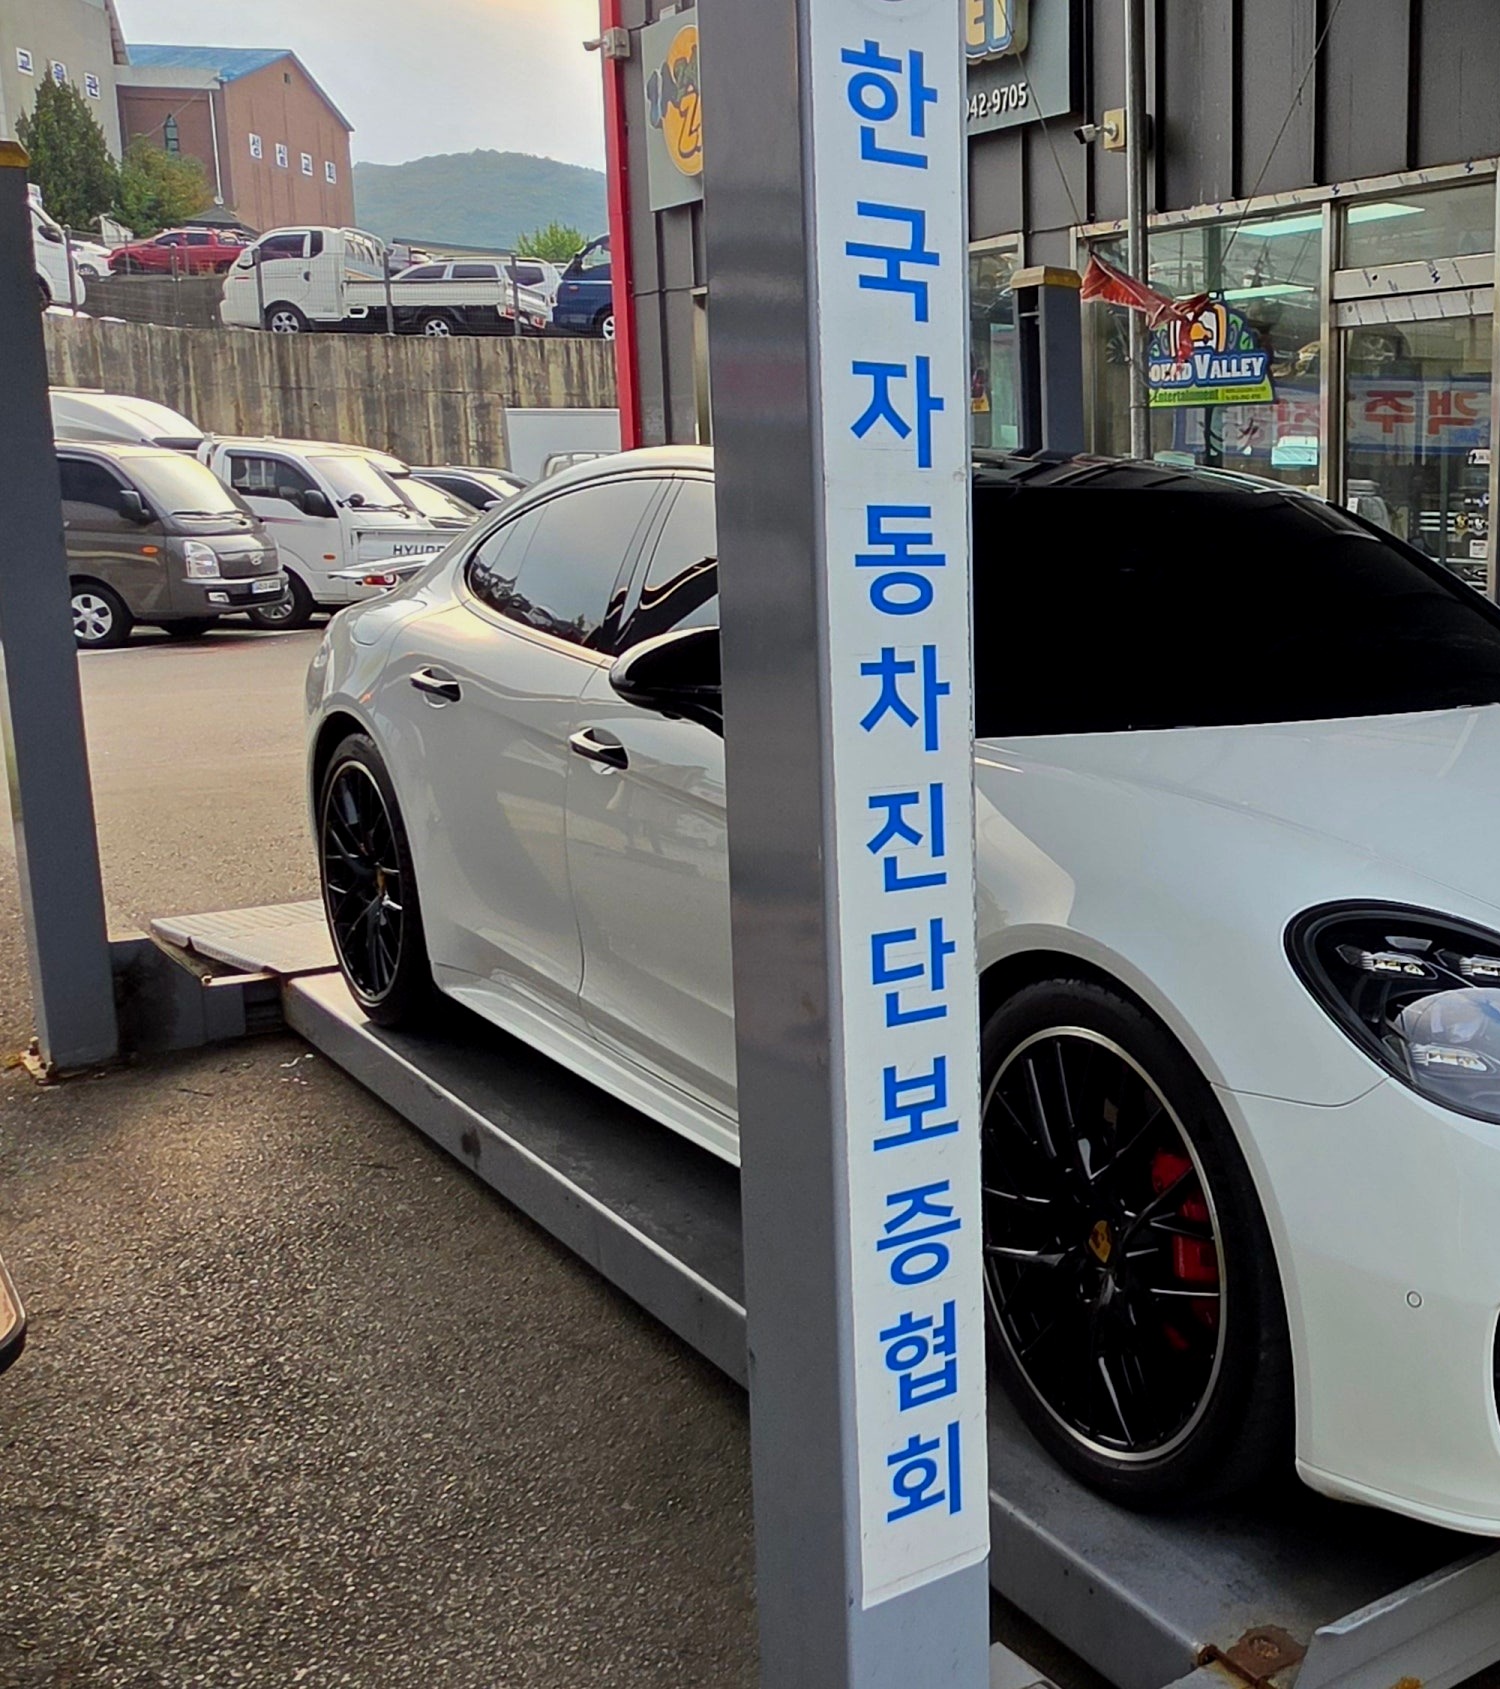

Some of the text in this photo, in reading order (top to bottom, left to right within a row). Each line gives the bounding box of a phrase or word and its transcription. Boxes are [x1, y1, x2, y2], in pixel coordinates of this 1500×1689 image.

[966, 82, 1027, 118] 42-9705
[1194, 353, 1264, 380] VALLEY
[841, 39, 961, 1523] 한국자동차진단보증협회
